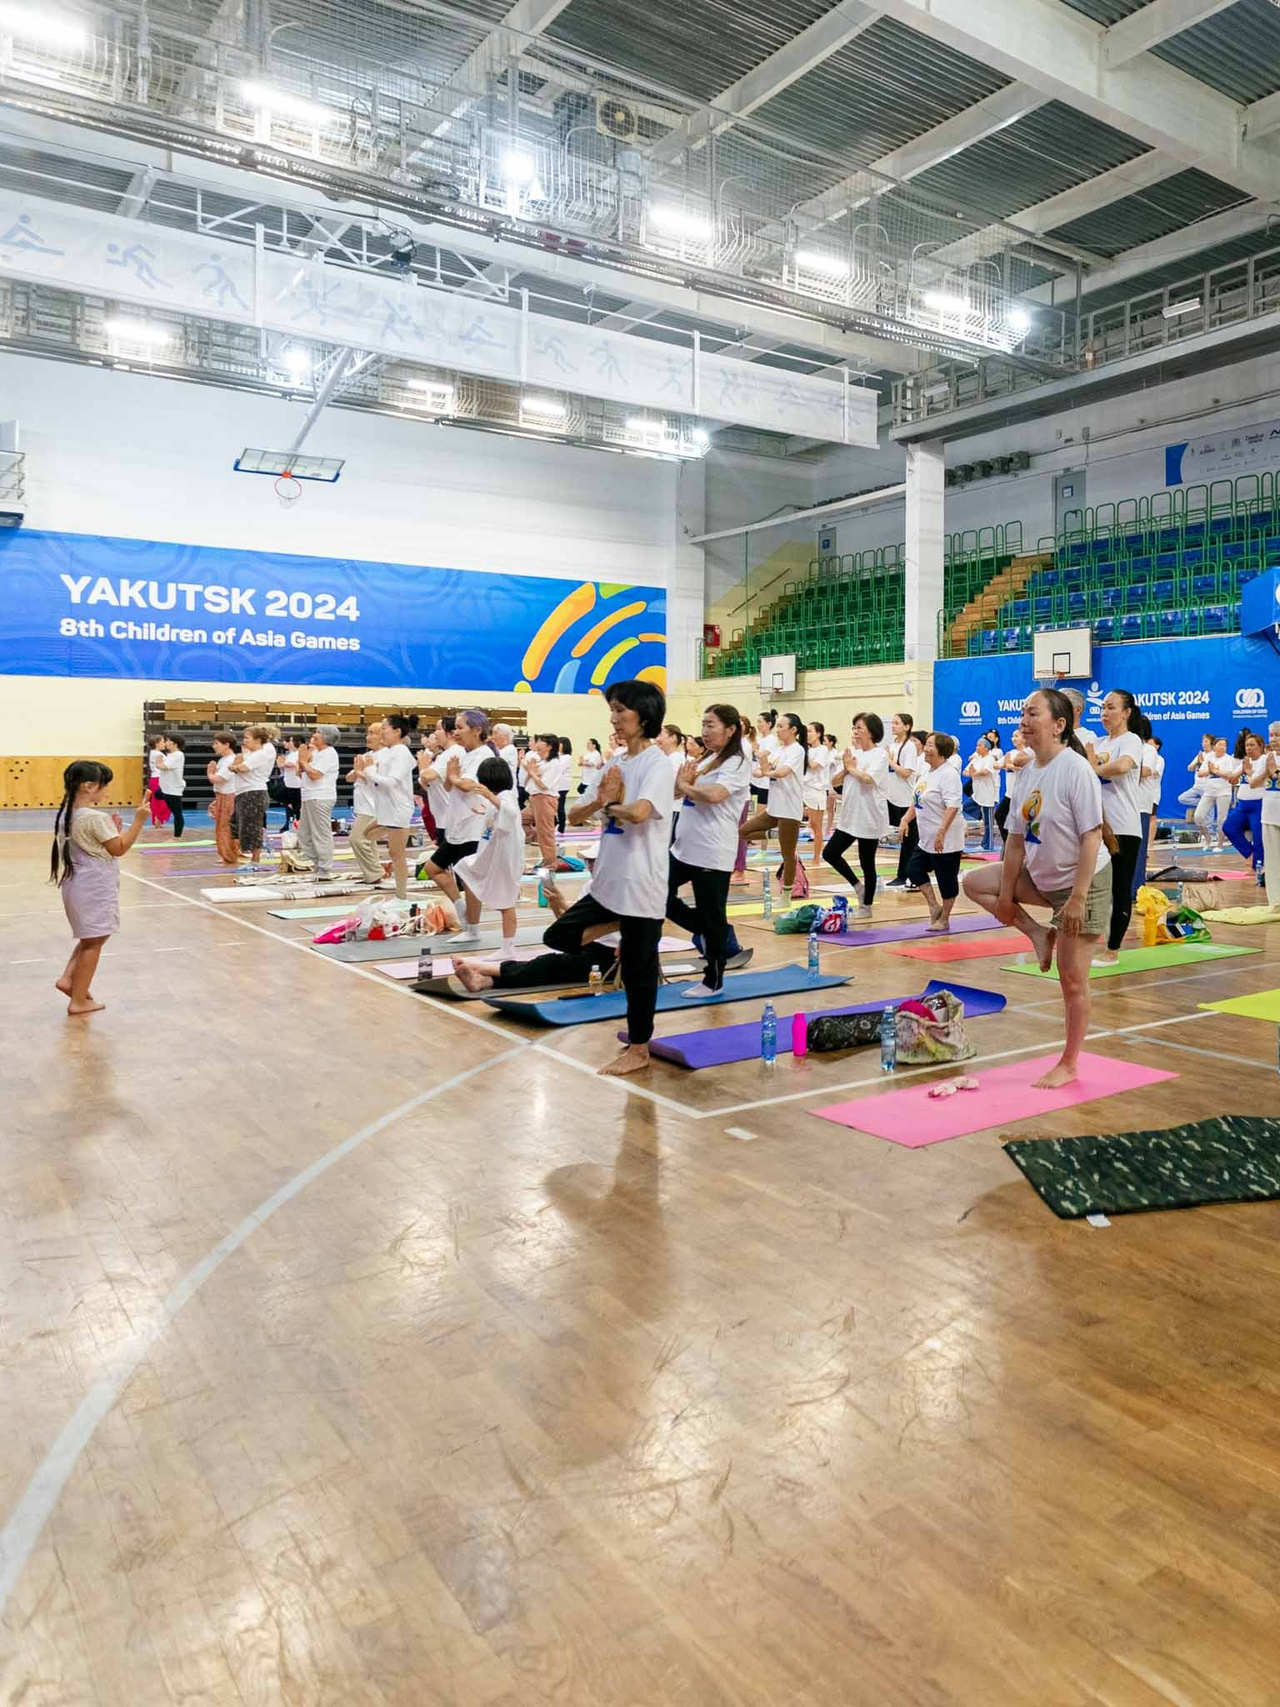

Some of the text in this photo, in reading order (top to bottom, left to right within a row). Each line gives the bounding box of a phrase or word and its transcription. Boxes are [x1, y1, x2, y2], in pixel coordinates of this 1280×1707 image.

[60, 574, 361, 622] YAKUTSK 2024
[60, 618, 361, 651] 8th Children of Asia Games
[997, 698, 1028, 711] YAKU
[1132, 690, 1210, 706] KUTSK 2024
[1163, 711, 1171, 720] of
[1171, 711, 1185, 720] Asia
[1186, 710, 1211, 720] Games
